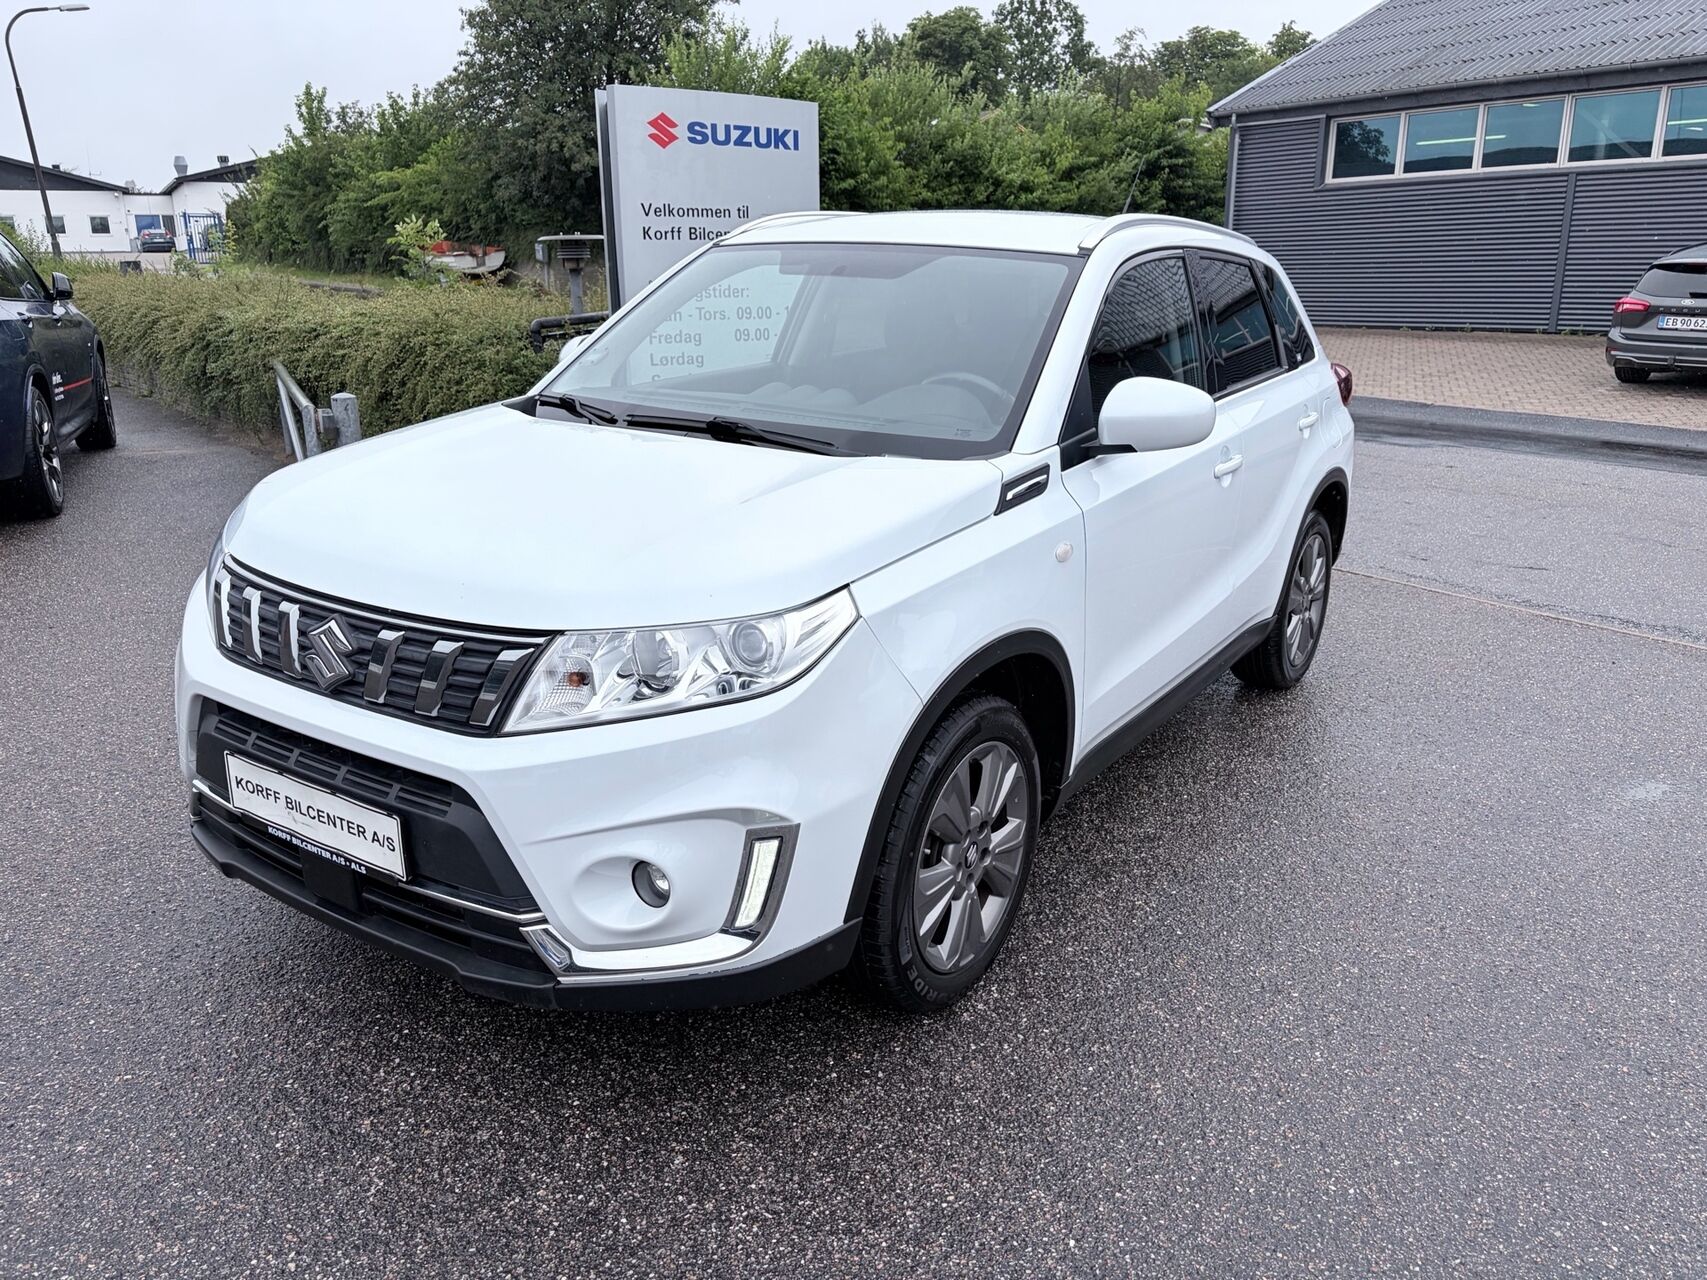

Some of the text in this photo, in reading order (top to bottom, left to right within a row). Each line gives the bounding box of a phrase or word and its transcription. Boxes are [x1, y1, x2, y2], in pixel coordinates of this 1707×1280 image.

[687, 121, 800, 151] SUZUKI
[641, 203, 750, 220] Velkommen til
[642, 226, 682, 241] Korff
[696, 307, 731, 322] Tors.
[736, 306, 773, 320] 09.00
[1665, 317, 1707, 329] EB 90 62
[649, 330, 702, 346] Fredag
[734, 328, 771, 342] 09.00
[650, 353, 704, 368] Lørdag
[235, 776, 396, 852] KORFF BILCENTER A/S
[267, 825, 367, 874] KORFF BILCENTER A/S ALS
